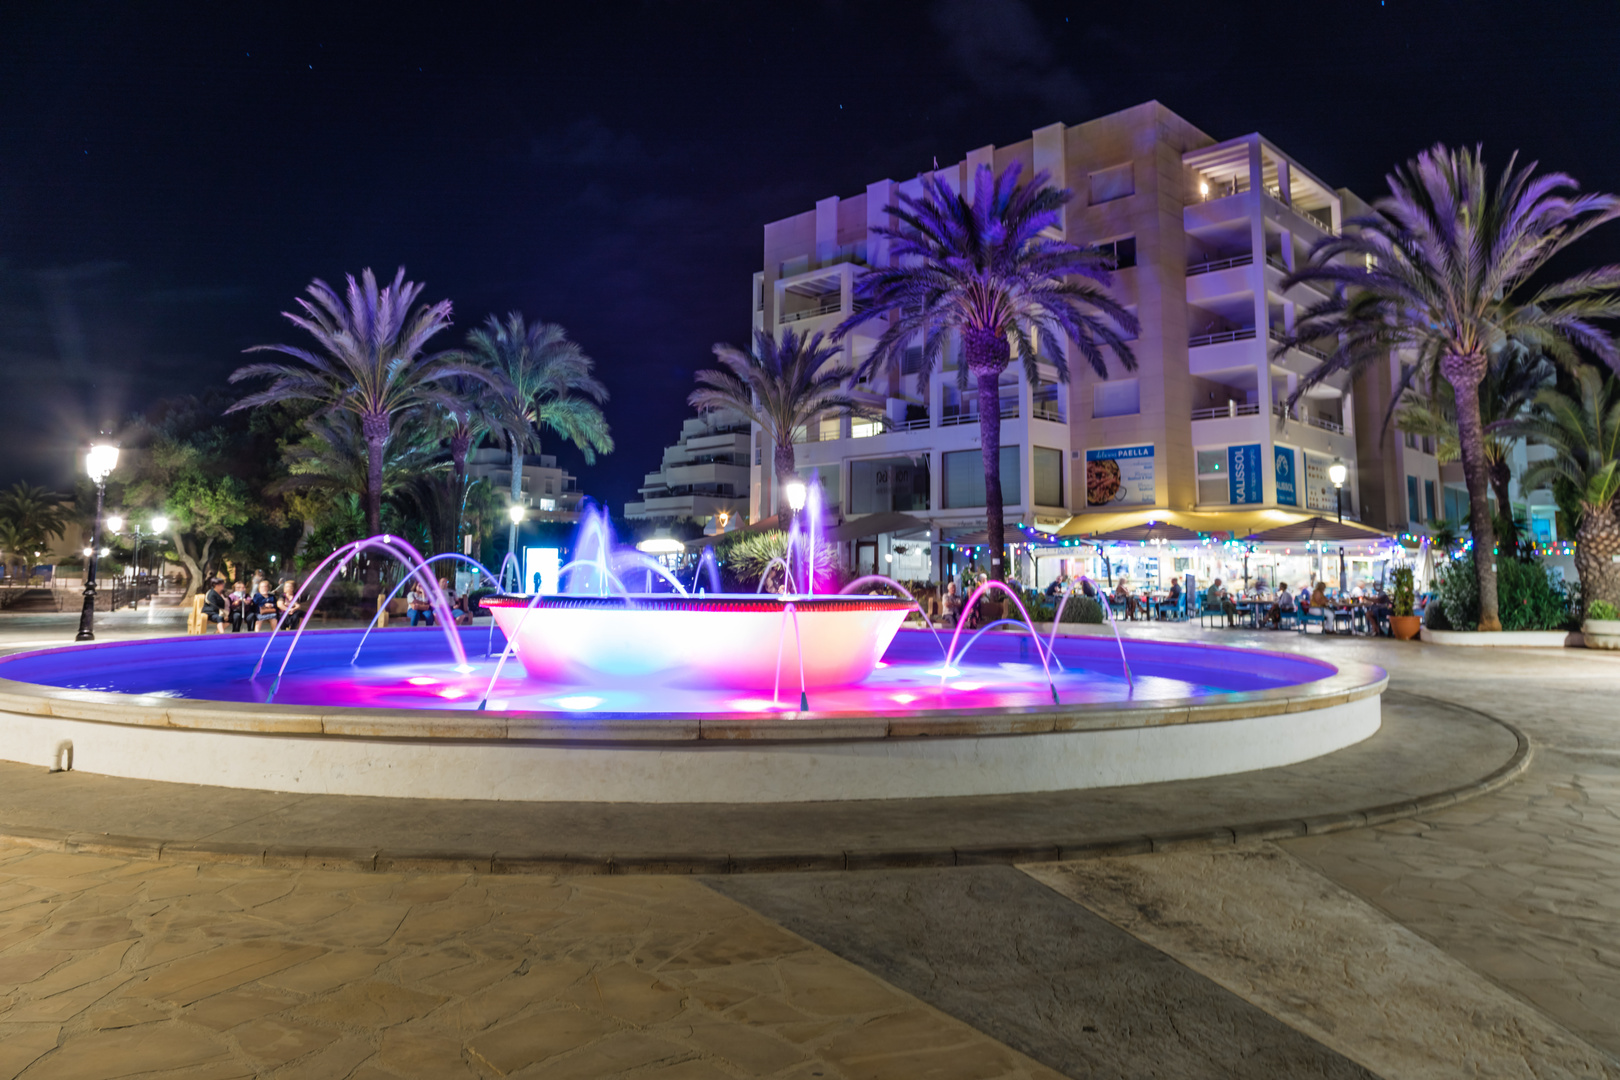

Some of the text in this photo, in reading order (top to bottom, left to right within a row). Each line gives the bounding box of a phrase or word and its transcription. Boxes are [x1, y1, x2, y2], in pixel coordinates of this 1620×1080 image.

[1118, 448, 1149, 457] PAELLA
[1235, 447, 1246, 503] KALISSOL
[1276, 481, 1294, 492] ALISSOL
